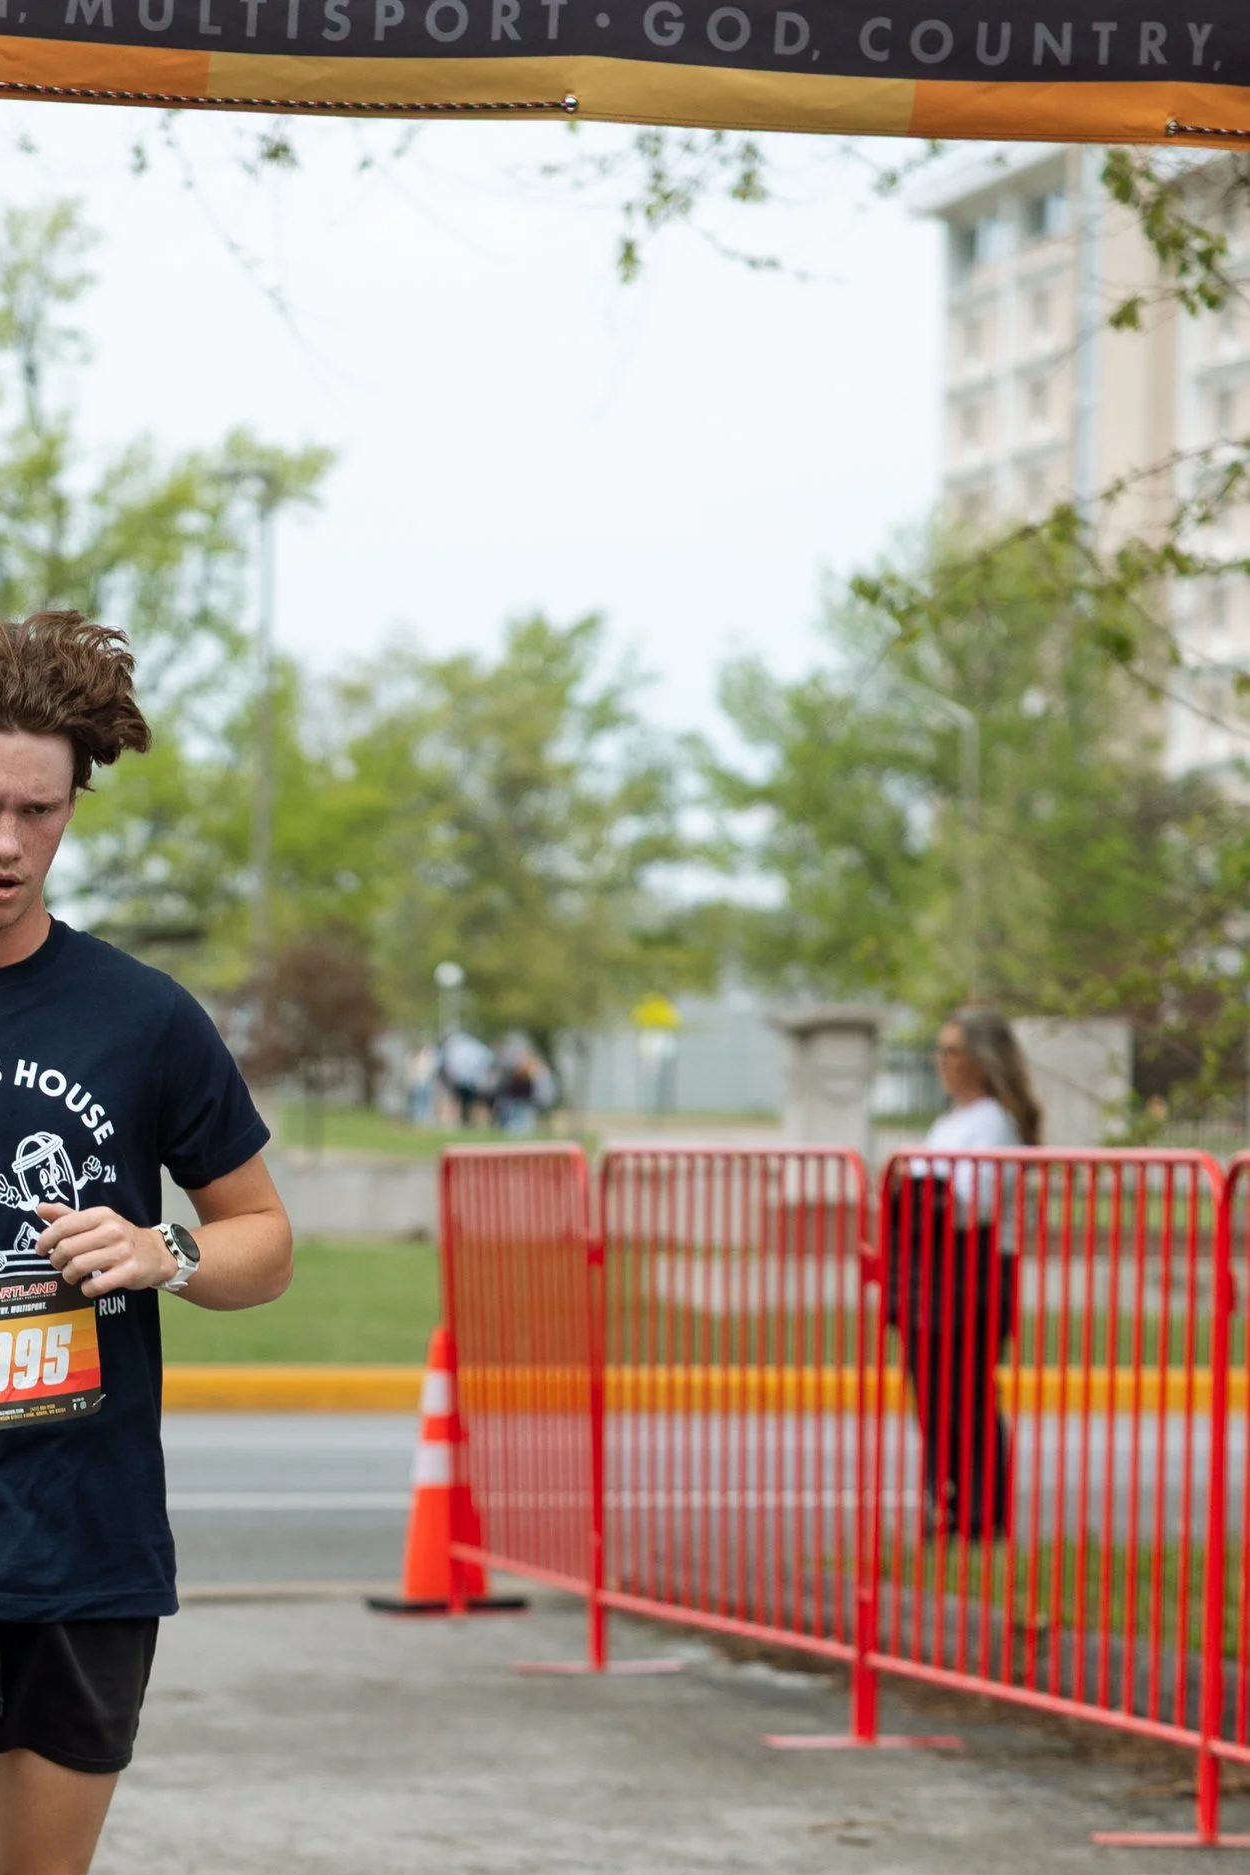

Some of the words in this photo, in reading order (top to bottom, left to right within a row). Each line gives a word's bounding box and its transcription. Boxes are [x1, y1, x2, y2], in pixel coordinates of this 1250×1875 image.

[65, 0, 567, 42] MULTISPORT
[643, 5, 821, 61] GOD,
[859, 16, 1221, 71] COUNTRY,
[14, 1059, 114, 1145] HOUSE
[103, 1165, 116, 1183] 26
[100, 1295, 126, 1316] RUN
